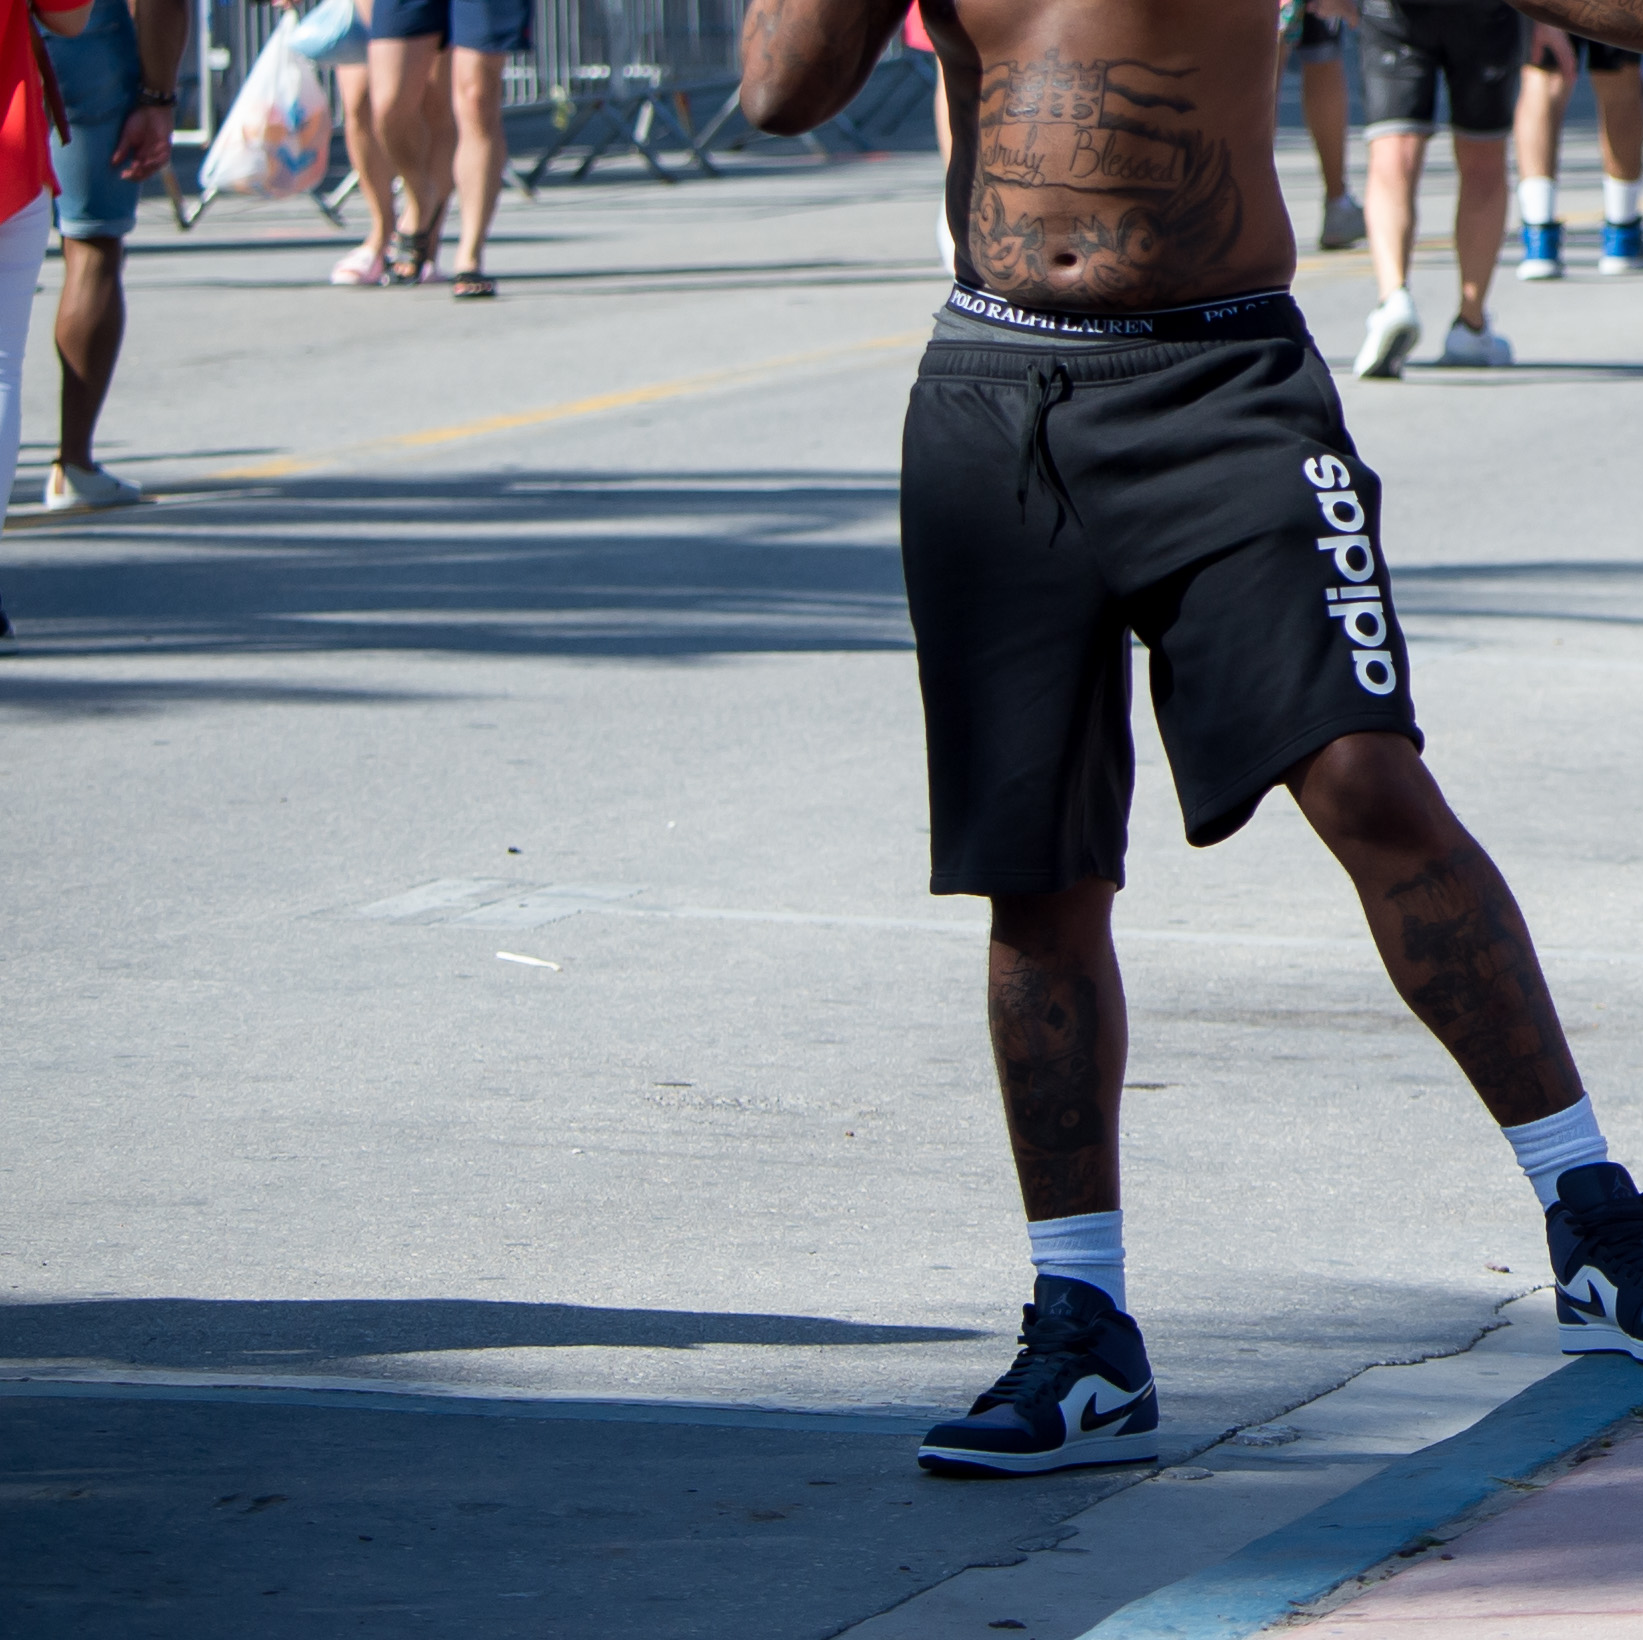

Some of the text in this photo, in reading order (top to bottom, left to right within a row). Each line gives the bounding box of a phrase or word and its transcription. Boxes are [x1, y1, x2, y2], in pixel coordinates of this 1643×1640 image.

[951, 289, 1154, 334] POLO RALPH LAUREN
[1302, 453, 1397, 696] adidas
